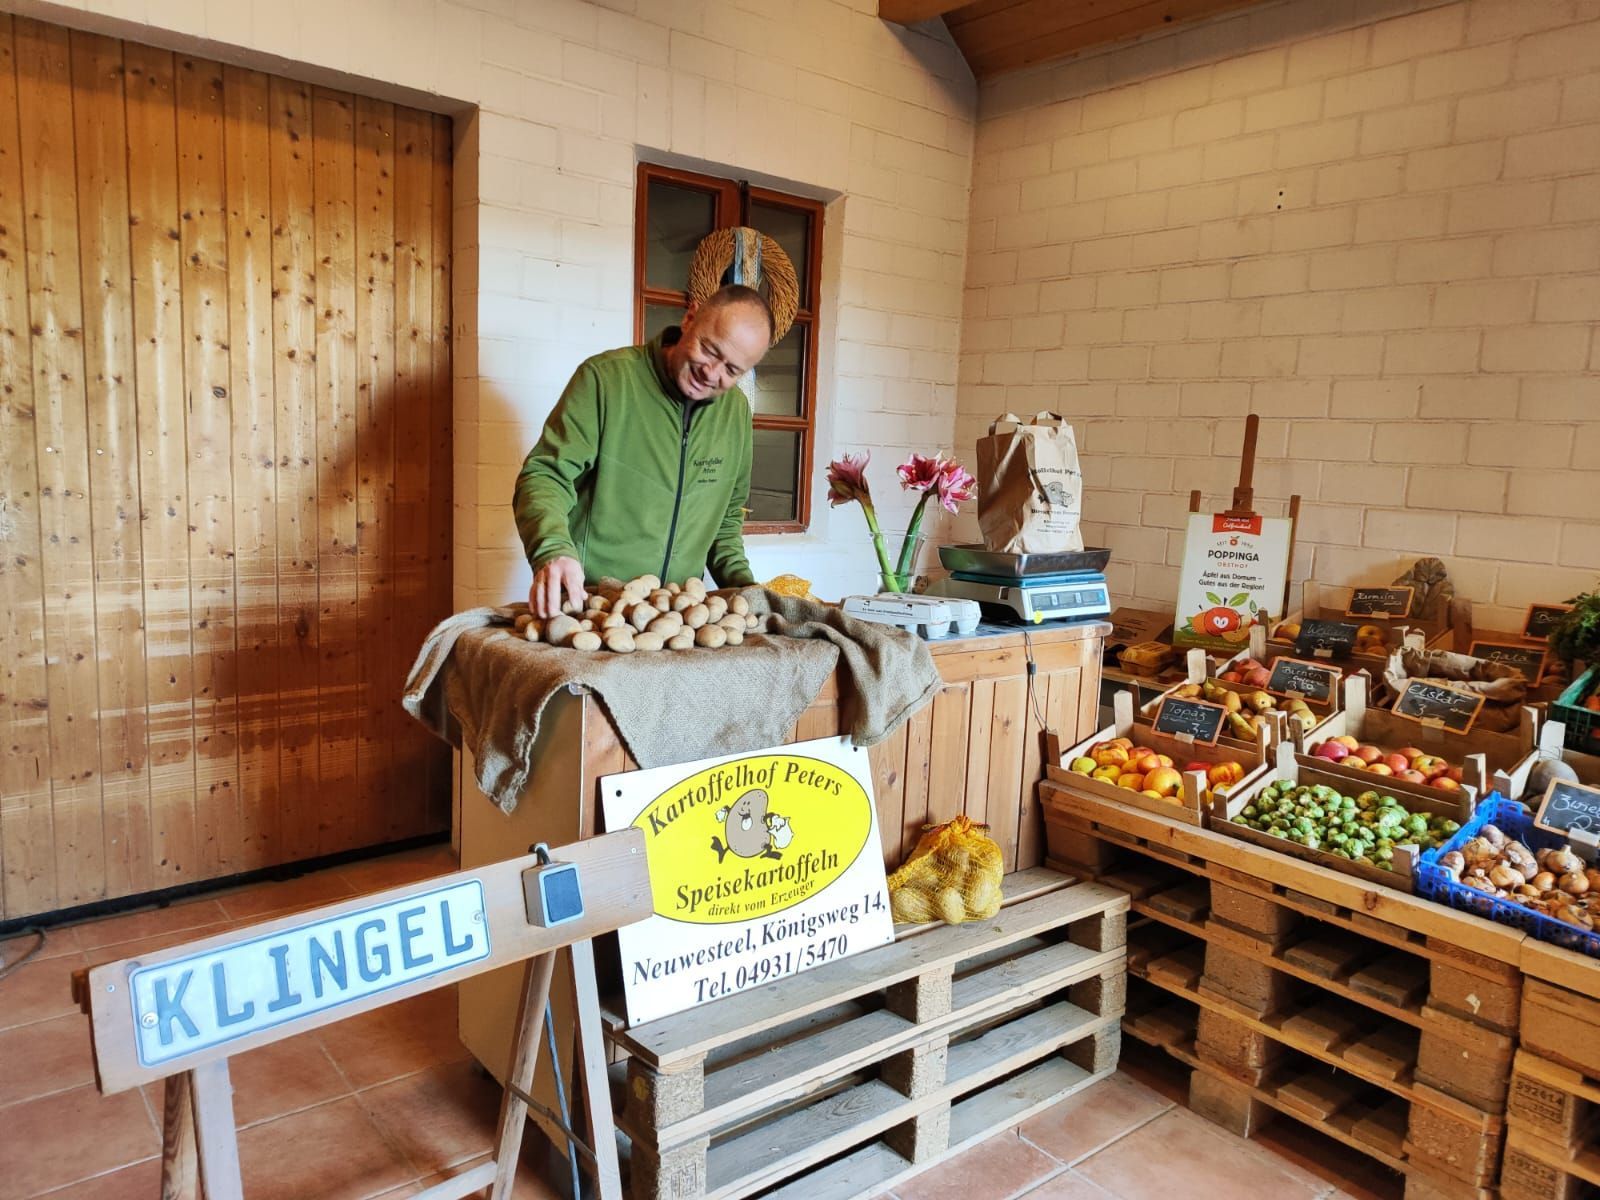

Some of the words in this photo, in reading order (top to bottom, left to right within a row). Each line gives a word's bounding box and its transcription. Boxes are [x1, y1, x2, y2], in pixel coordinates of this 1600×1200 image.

[1207, 549, 1260, 562] POPPINGA
[1217, 561, 1248, 569] OBSTHOF
[646, 761, 779, 838] Kartoffelhof
[783, 761, 843, 797] Peters
[675, 848, 840, 913] Speisekartoffeln
[707, 902, 741, 917] direkt
[744, 900, 767, 913] vom
[770, 878, 816, 906] Erzeuger
[632, 928, 757, 986] Neuwesteel,
[761, 903, 860, 946] Königsweg
[863, 890, 886, 915] 14,
[152, 899, 475, 1046] KLINGEL
[694, 973, 732, 1004] Tel.
